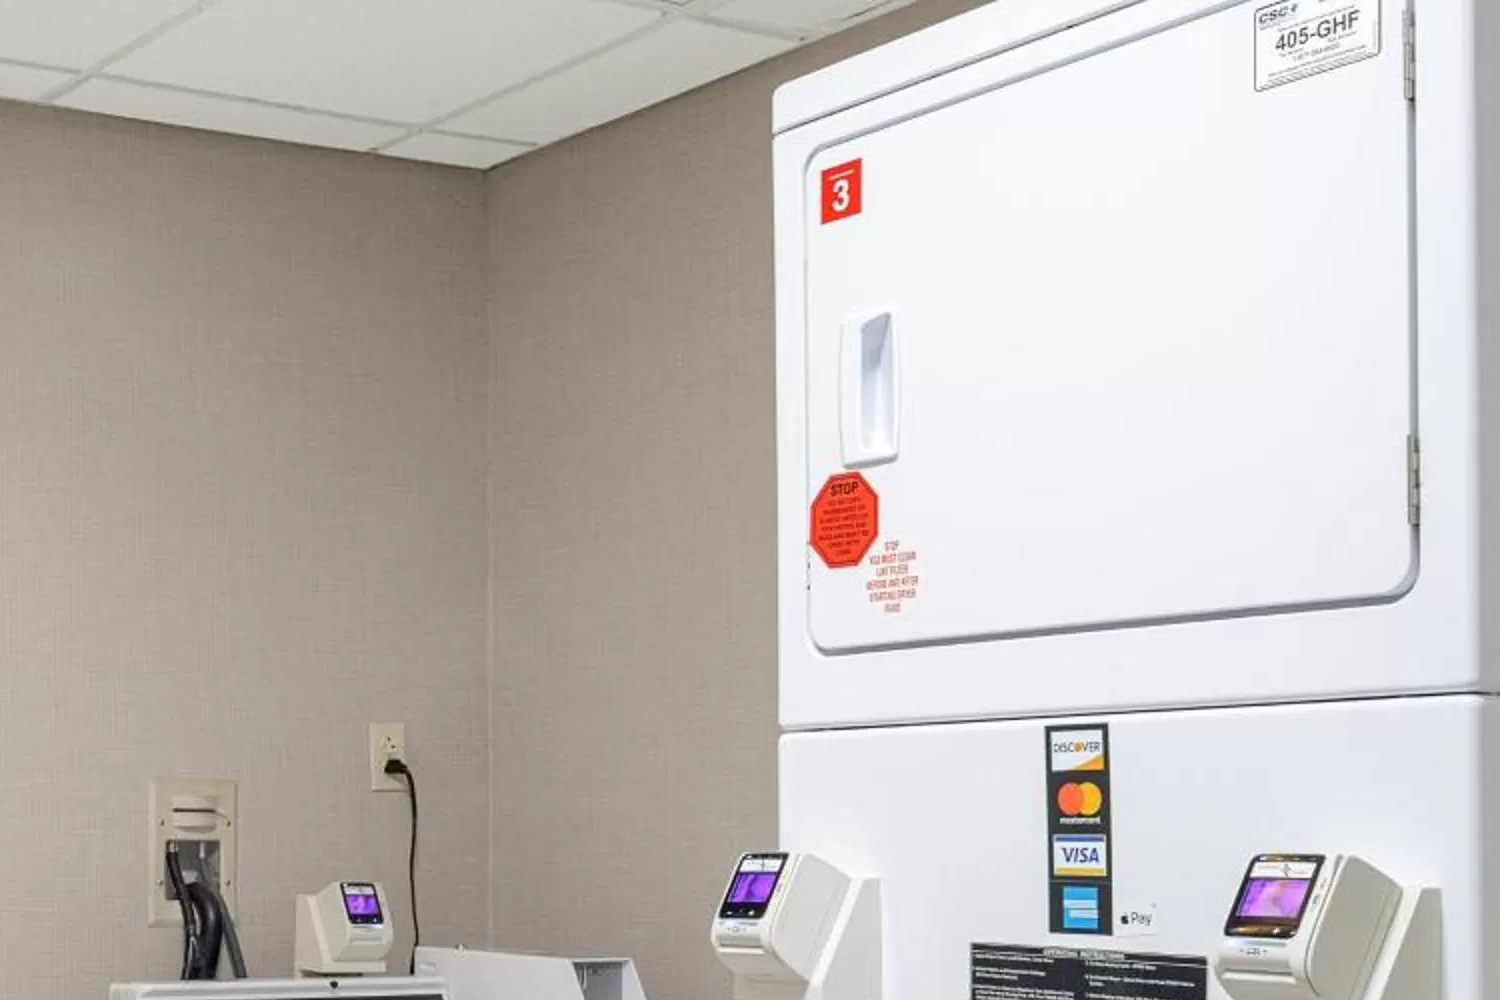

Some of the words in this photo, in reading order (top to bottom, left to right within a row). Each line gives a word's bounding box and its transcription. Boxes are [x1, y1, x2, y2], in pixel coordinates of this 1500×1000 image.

[1275, 9, 1361, 51] 405-GHF
[832, 179, 850, 212] 3
[830, 481, 860, 497] STOP
[1053, 741, 1101, 753] DISCOVER
[1061, 847, 1100, 863] VISA
[1130, 912, 1152, 925] Pay
